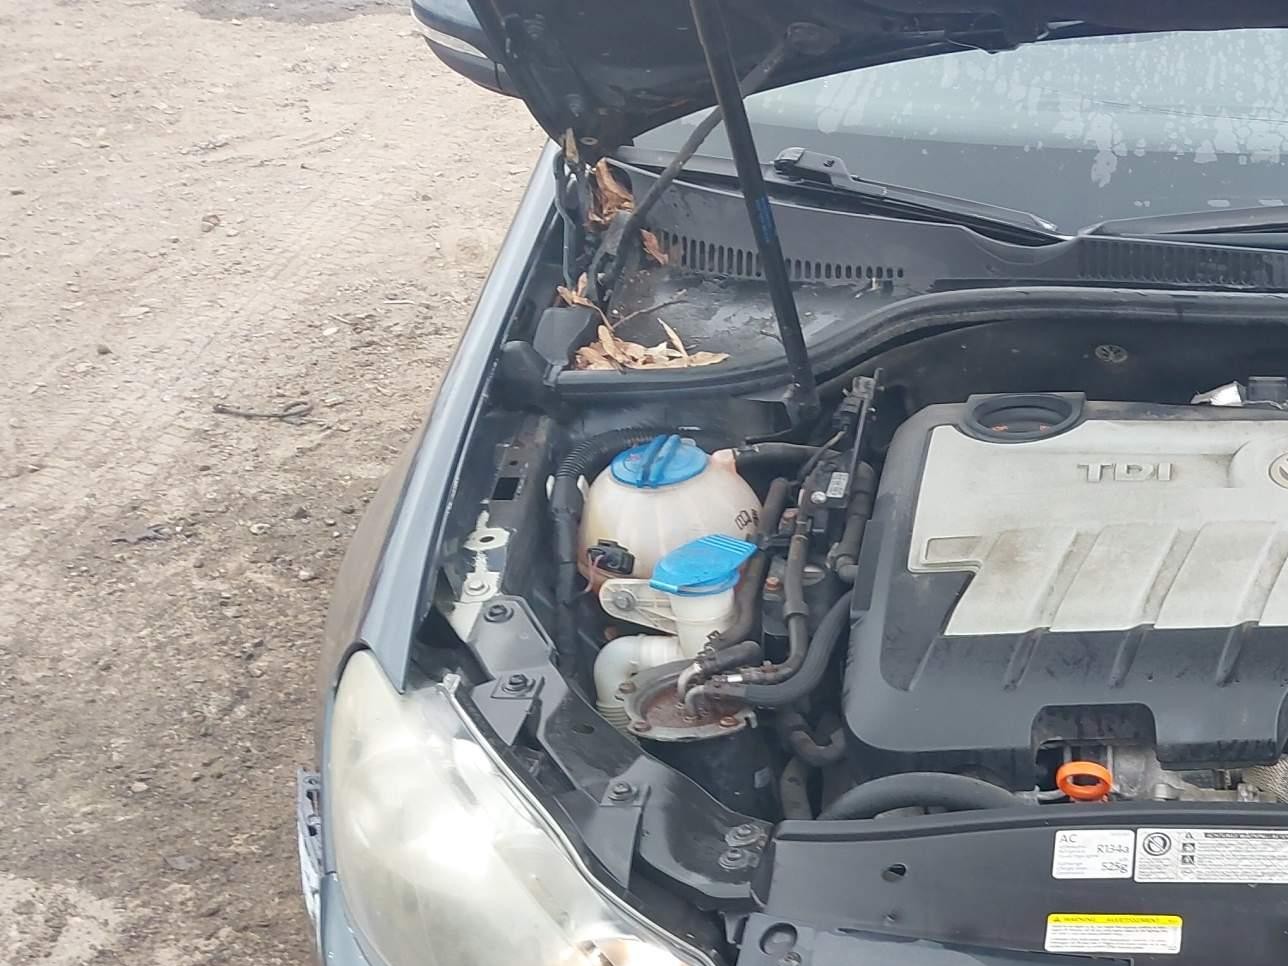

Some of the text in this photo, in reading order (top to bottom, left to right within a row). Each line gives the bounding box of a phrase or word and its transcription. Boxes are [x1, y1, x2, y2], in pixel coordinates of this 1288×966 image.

[1077, 463, 1172, 483] TDI
[1059, 833, 1078, 844] AC
[1096, 844, 1130, 854] R134a
